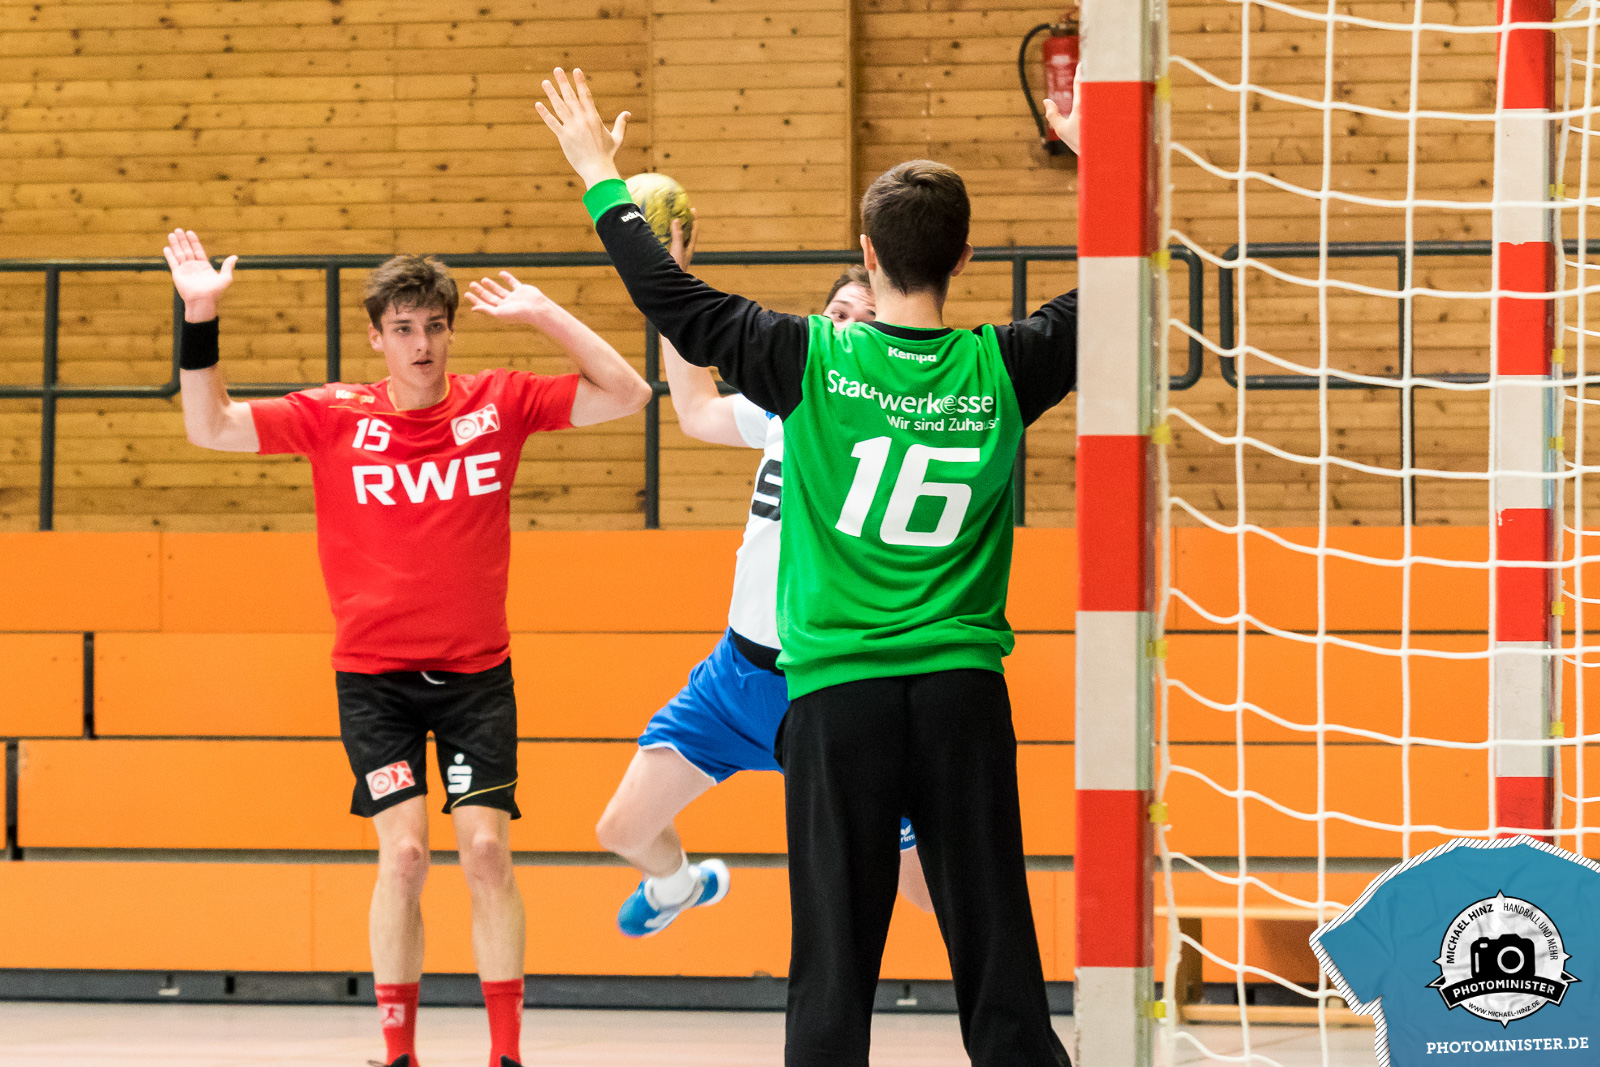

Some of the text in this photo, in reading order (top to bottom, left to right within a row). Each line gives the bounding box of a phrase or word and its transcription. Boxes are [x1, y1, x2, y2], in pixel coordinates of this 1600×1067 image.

[887, 346, 937, 364] Kempa
[352, 417, 392, 452] 15
[886, 414, 910, 430] Wir
[913, 416, 944, 431] sind
[352, 451, 502, 506] RWE
[835, 435, 980, 547] 16
